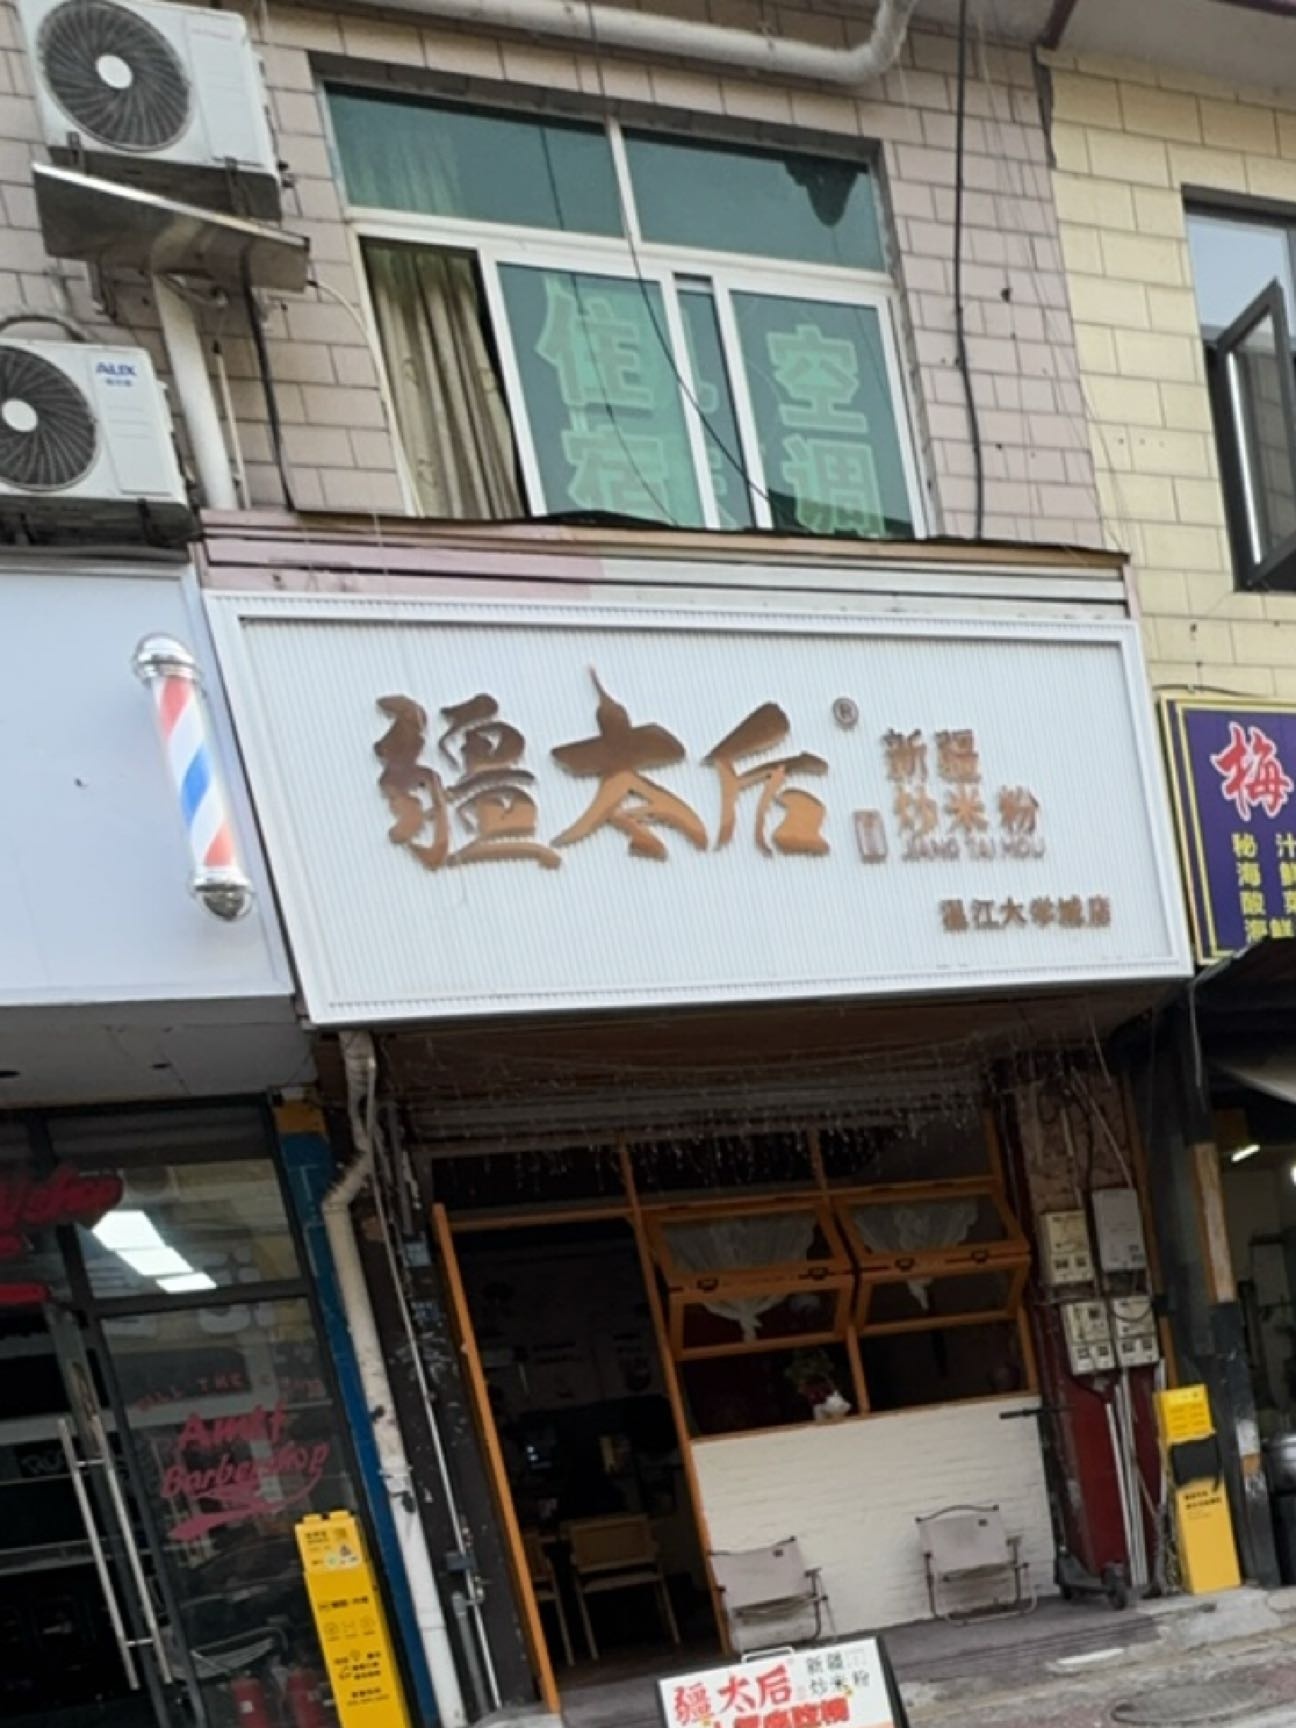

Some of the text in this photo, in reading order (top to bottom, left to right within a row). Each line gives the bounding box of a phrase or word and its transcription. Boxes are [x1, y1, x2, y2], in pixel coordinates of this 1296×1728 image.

[374, 665, 830, 872] 疆太后
[880, 728, 980, 783] 新疆
